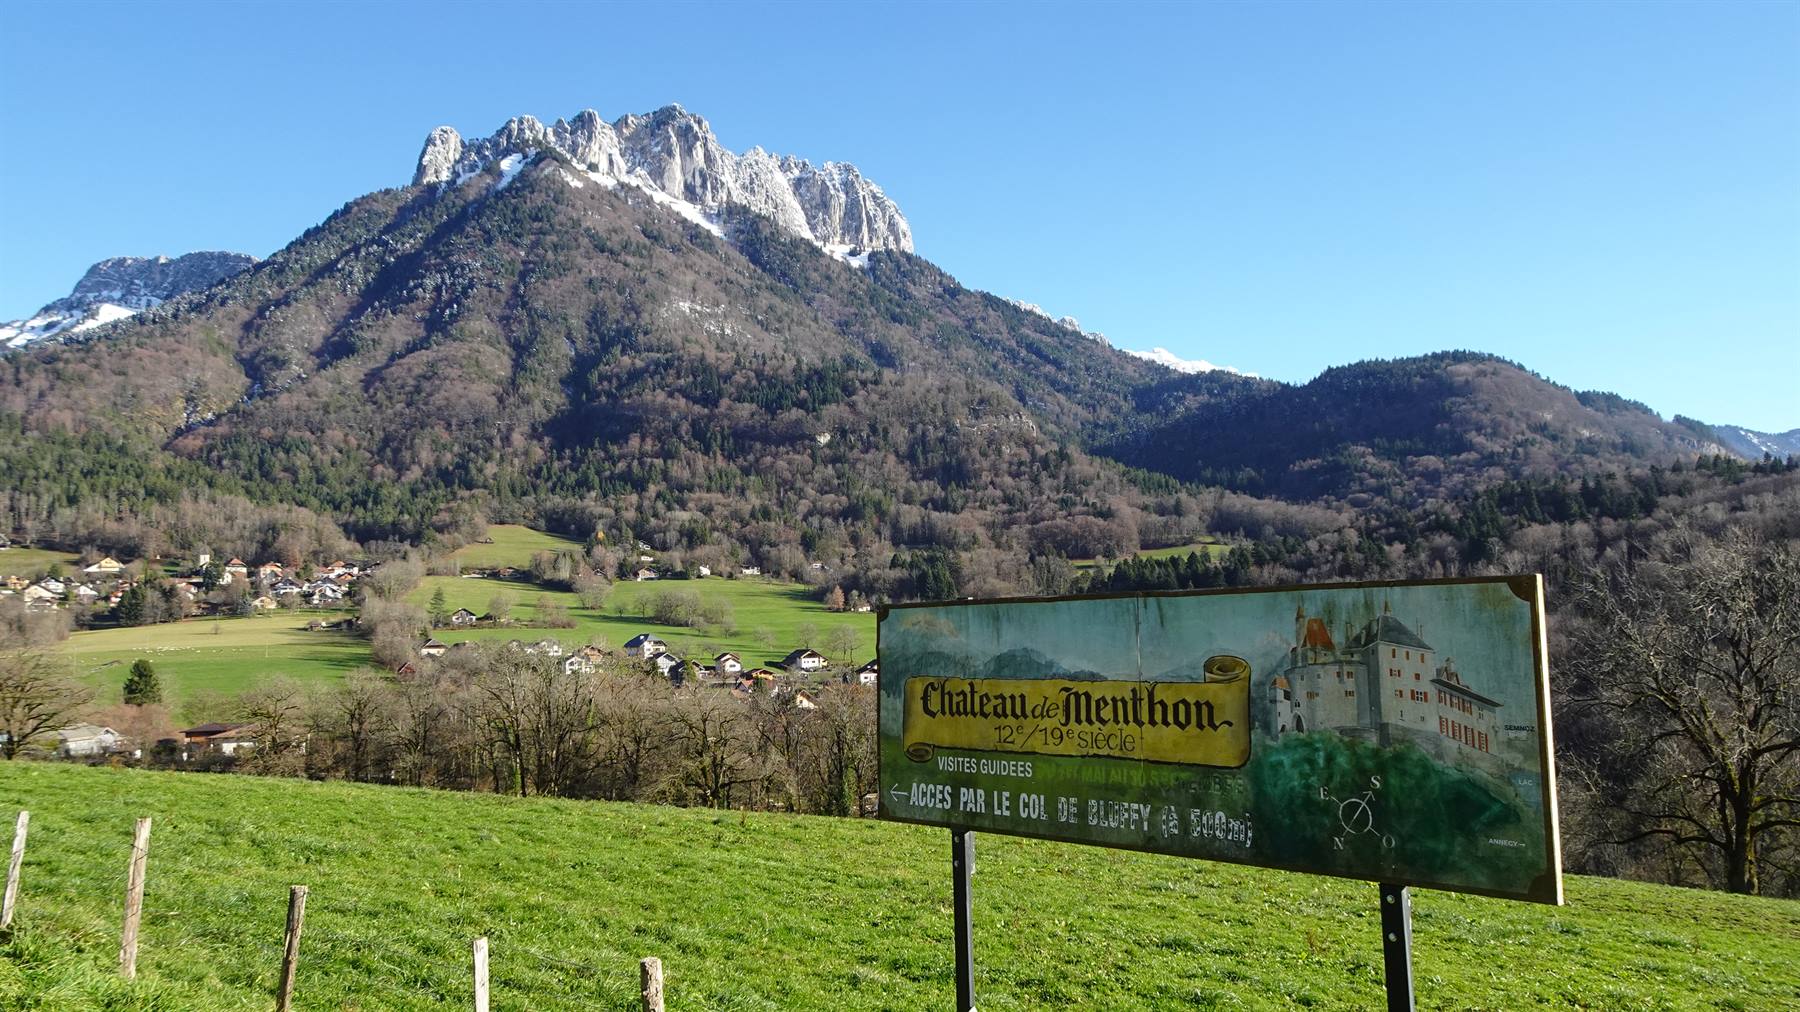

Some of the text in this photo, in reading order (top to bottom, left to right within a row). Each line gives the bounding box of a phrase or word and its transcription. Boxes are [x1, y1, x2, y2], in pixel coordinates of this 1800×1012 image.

[920, 678, 1233, 732] Chateau de Menthon
[938, 756, 977, 774] VISITES
[980, 759, 1033, 778] GUIDEES
[1370, 775, 1382, 789] S
[1320, 786, 1330, 800] E
[909, 782, 952, 810] ACCES
[959, 787, 985, 813] PAR
[993, 790, 1011, 817] LE
[1019, 793, 1049, 820] COL
[1057, 796, 1078, 824] DE
[1088, 799, 1151, 832] BLUFFY
[1333, 836, 1345, 850] N
[1382, 834, 1396, 849] O
[1488, 838, 1519, 847] ANNECY
